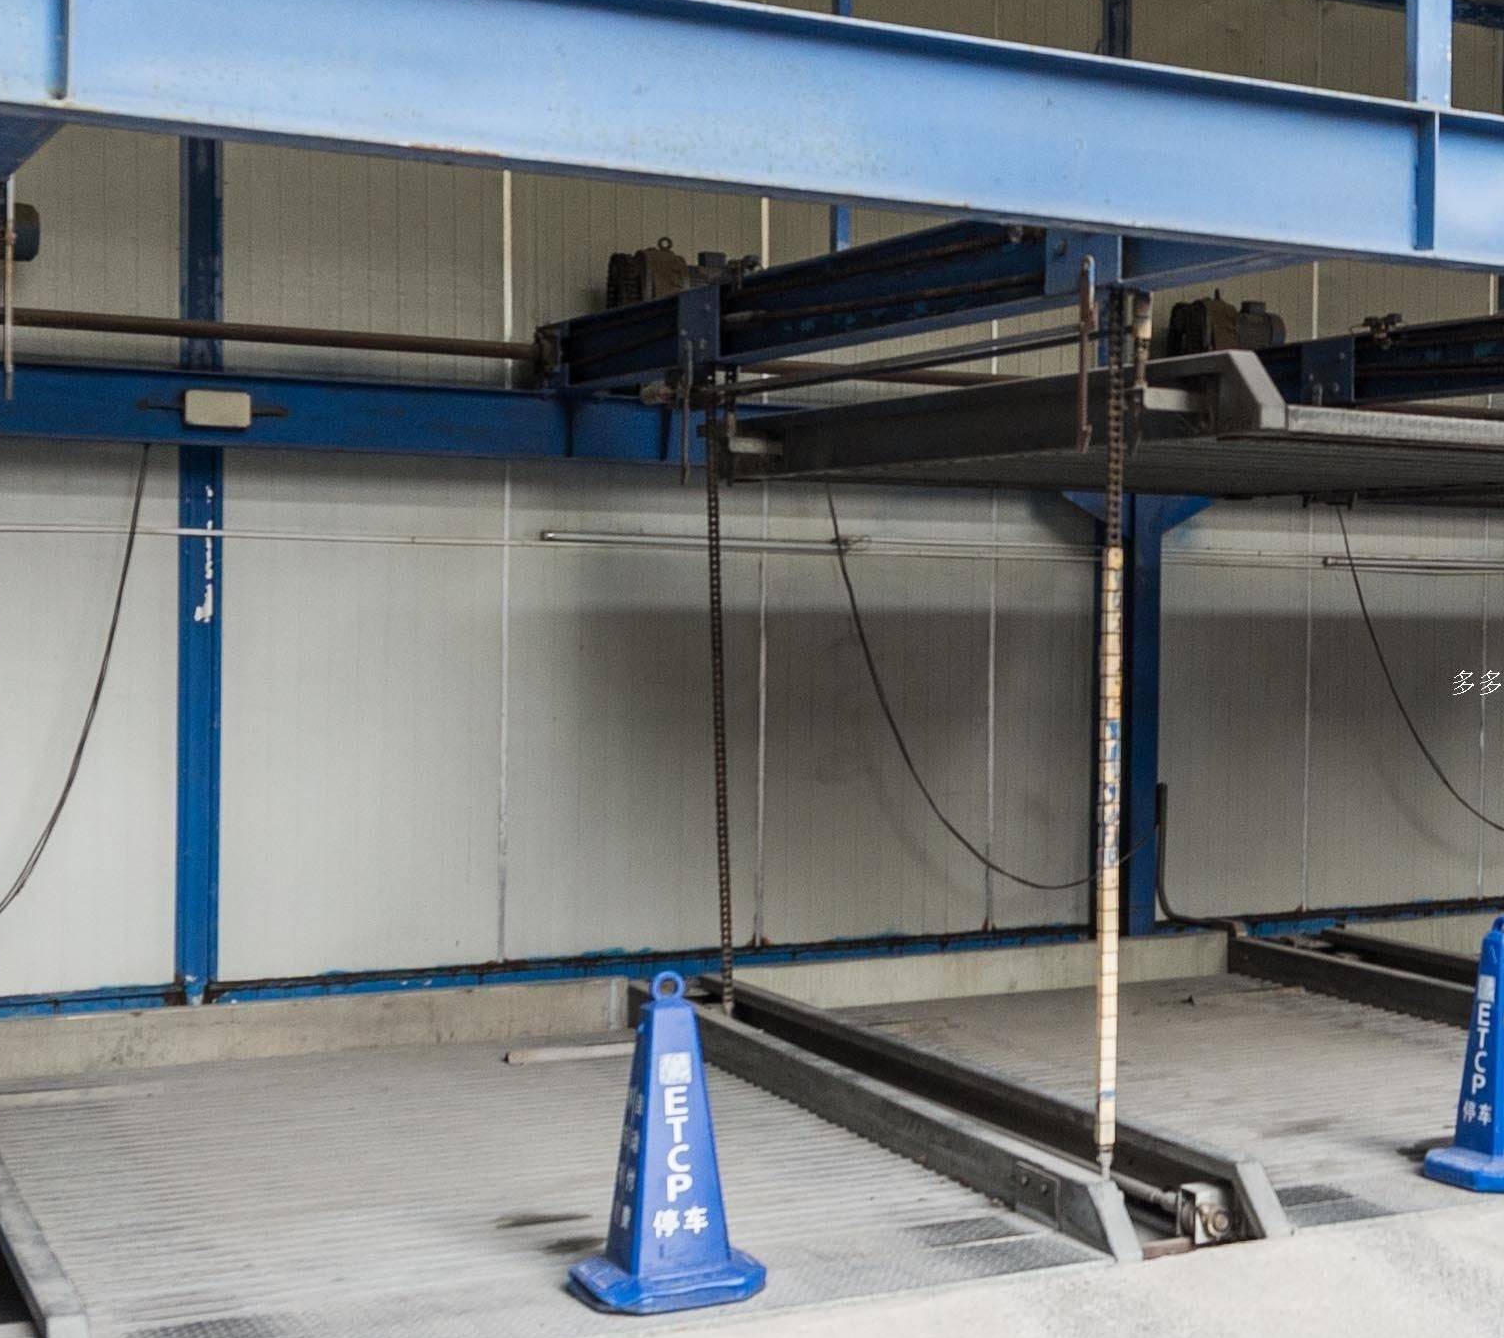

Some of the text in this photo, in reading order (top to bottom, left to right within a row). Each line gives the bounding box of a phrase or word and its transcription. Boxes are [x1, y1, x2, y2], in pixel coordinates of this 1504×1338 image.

[1471, 1002, 1492, 1095] ETCP
[663, 1085, 694, 1203] ETCP
[1462, 1099, 1493, 1128] 停车
[652, 1205, 710, 1239] 停车
